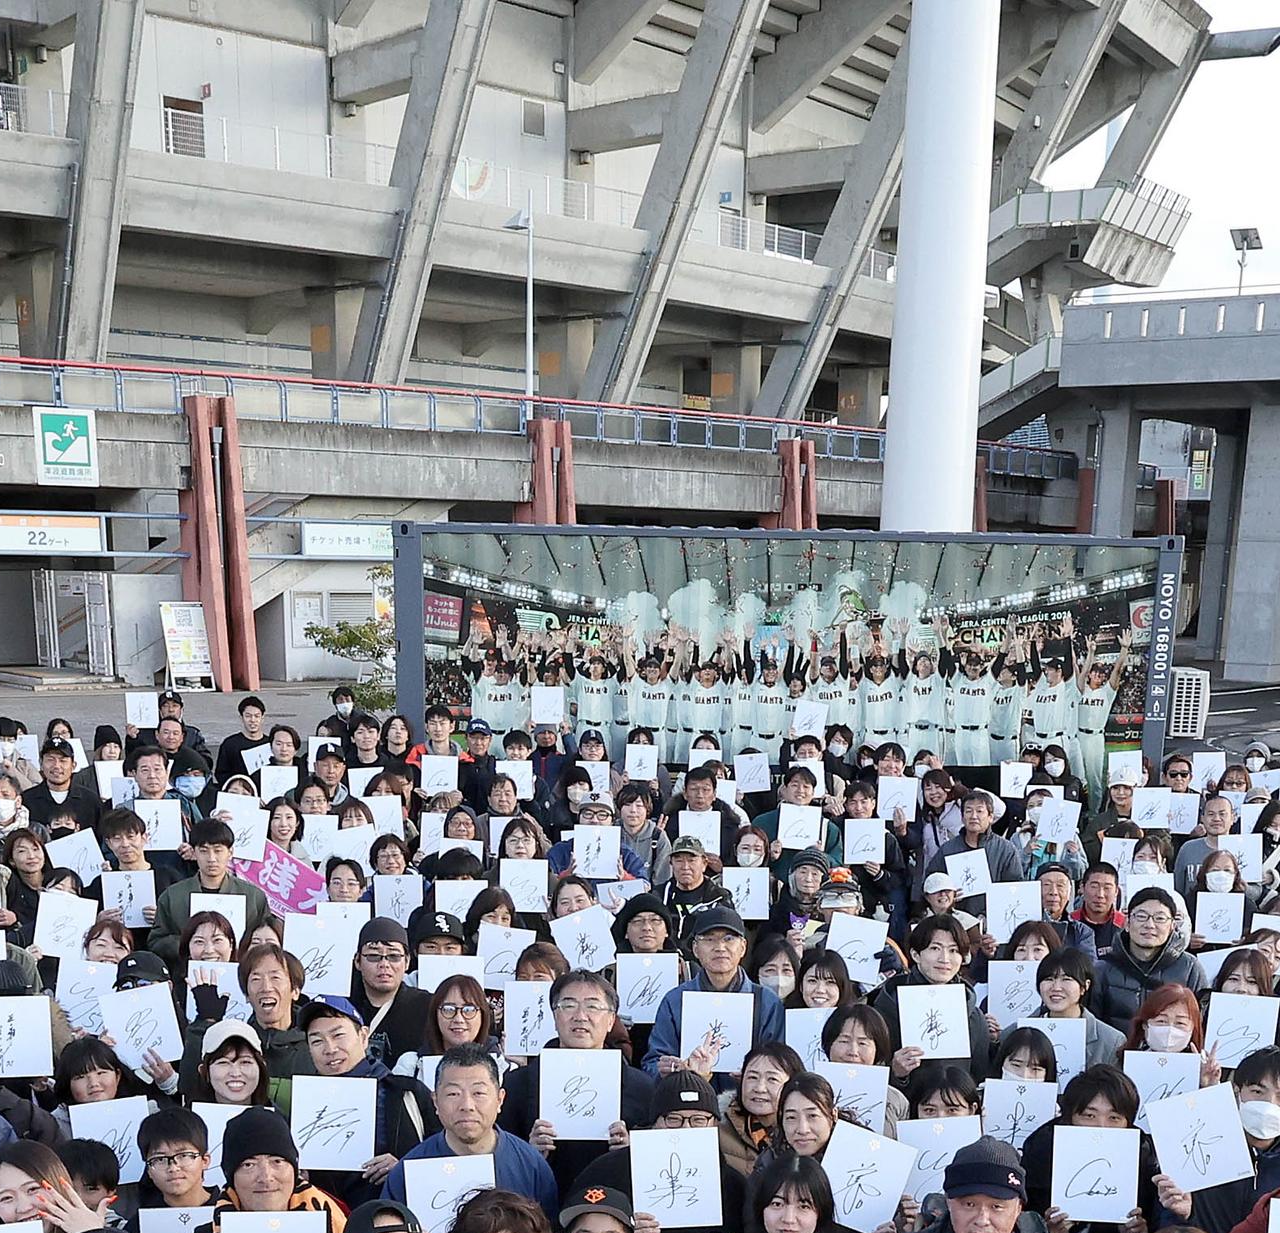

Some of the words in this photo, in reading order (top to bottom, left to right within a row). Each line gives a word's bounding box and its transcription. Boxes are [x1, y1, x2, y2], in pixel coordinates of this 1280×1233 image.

[1158, 573, 1175, 620] NOYO
[567, 614, 587, 624] JERA
[1017, 612, 1049, 625] LEAGUE
[1153, 626, 1170, 680] 168001
